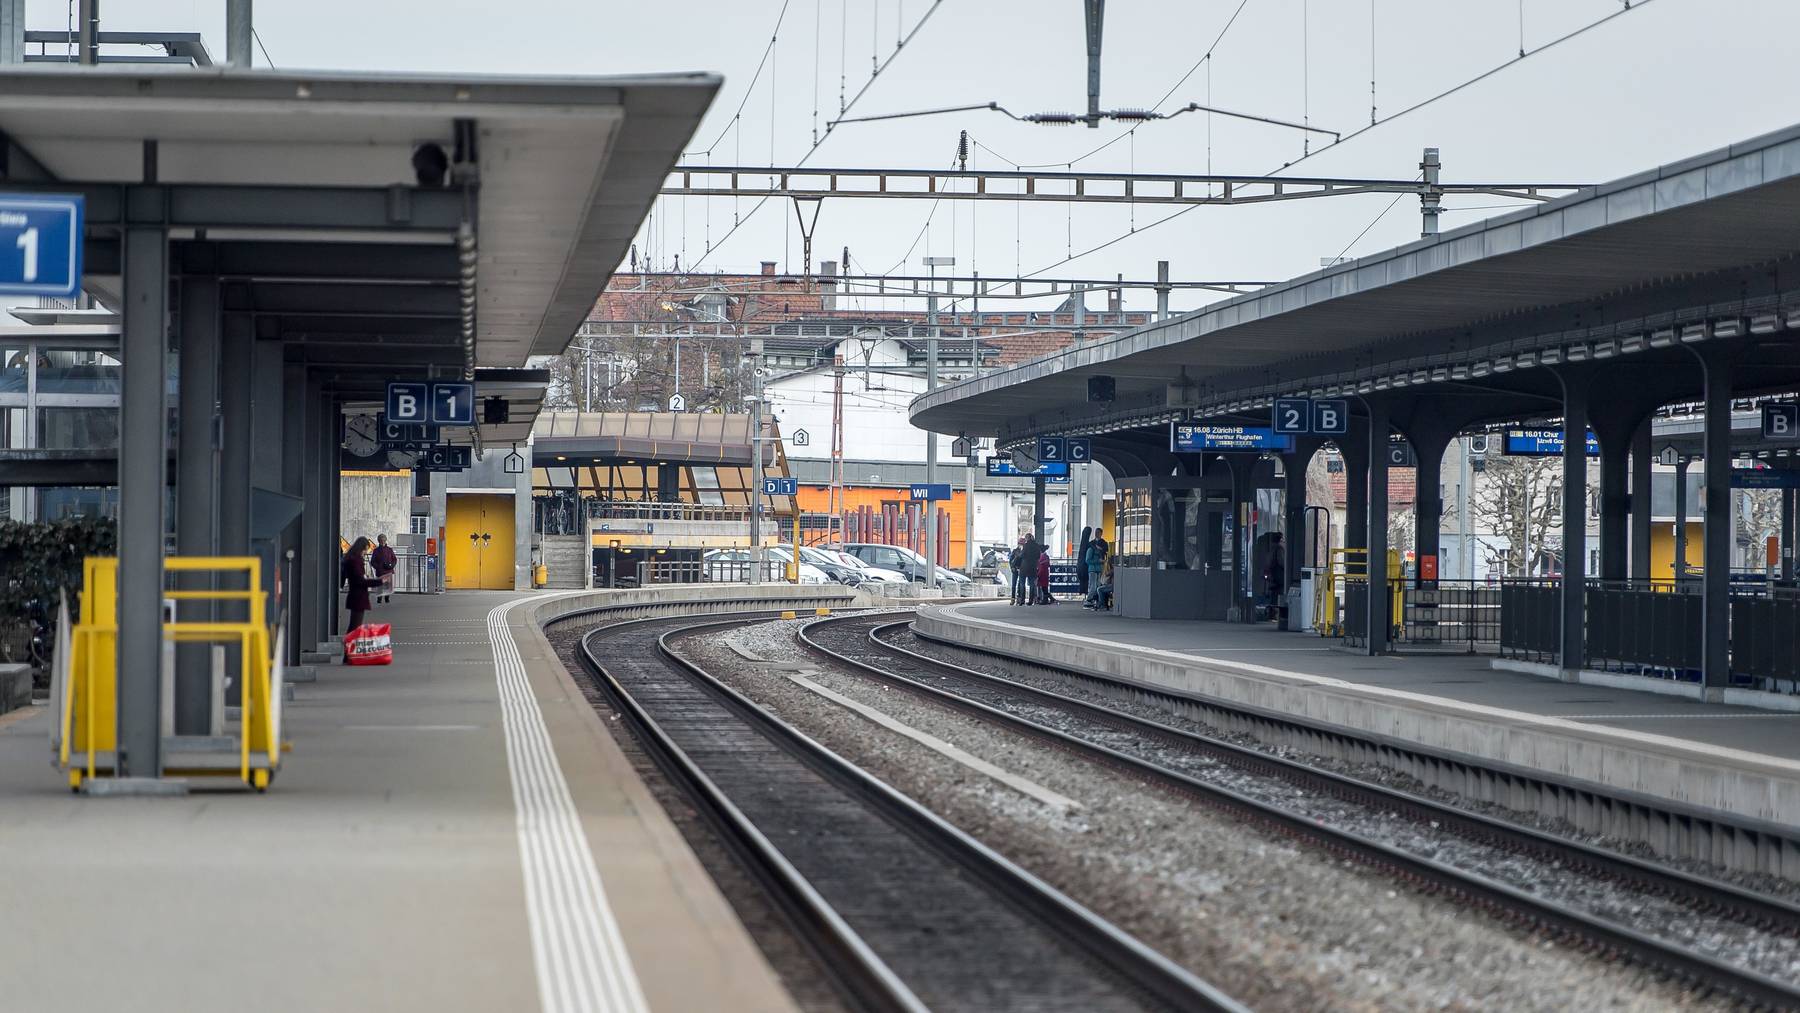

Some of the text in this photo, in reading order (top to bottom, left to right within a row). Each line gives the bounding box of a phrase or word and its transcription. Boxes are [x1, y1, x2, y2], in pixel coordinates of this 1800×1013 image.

[16, 227, 39, 282] 1
[398, 395, 456, 418] B 1
[674, 396, 681, 409] 2
[1285, 409, 1338, 429] 2 B
[1773, 414, 1788, 433] B
[386, 424, 427, 438] C 1
[1212, 426, 1233, 434] Zürich
[797, 432, 805, 444] 3
[958, 441, 964, 455] 1
[1046, 444, 1084, 459] 2 C
[433, 453, 463, 465] C 1
[1391, 449, 1403, 463] C
[511, 457, 516, 471] 1
[767, 483, 791, 493] D 1
